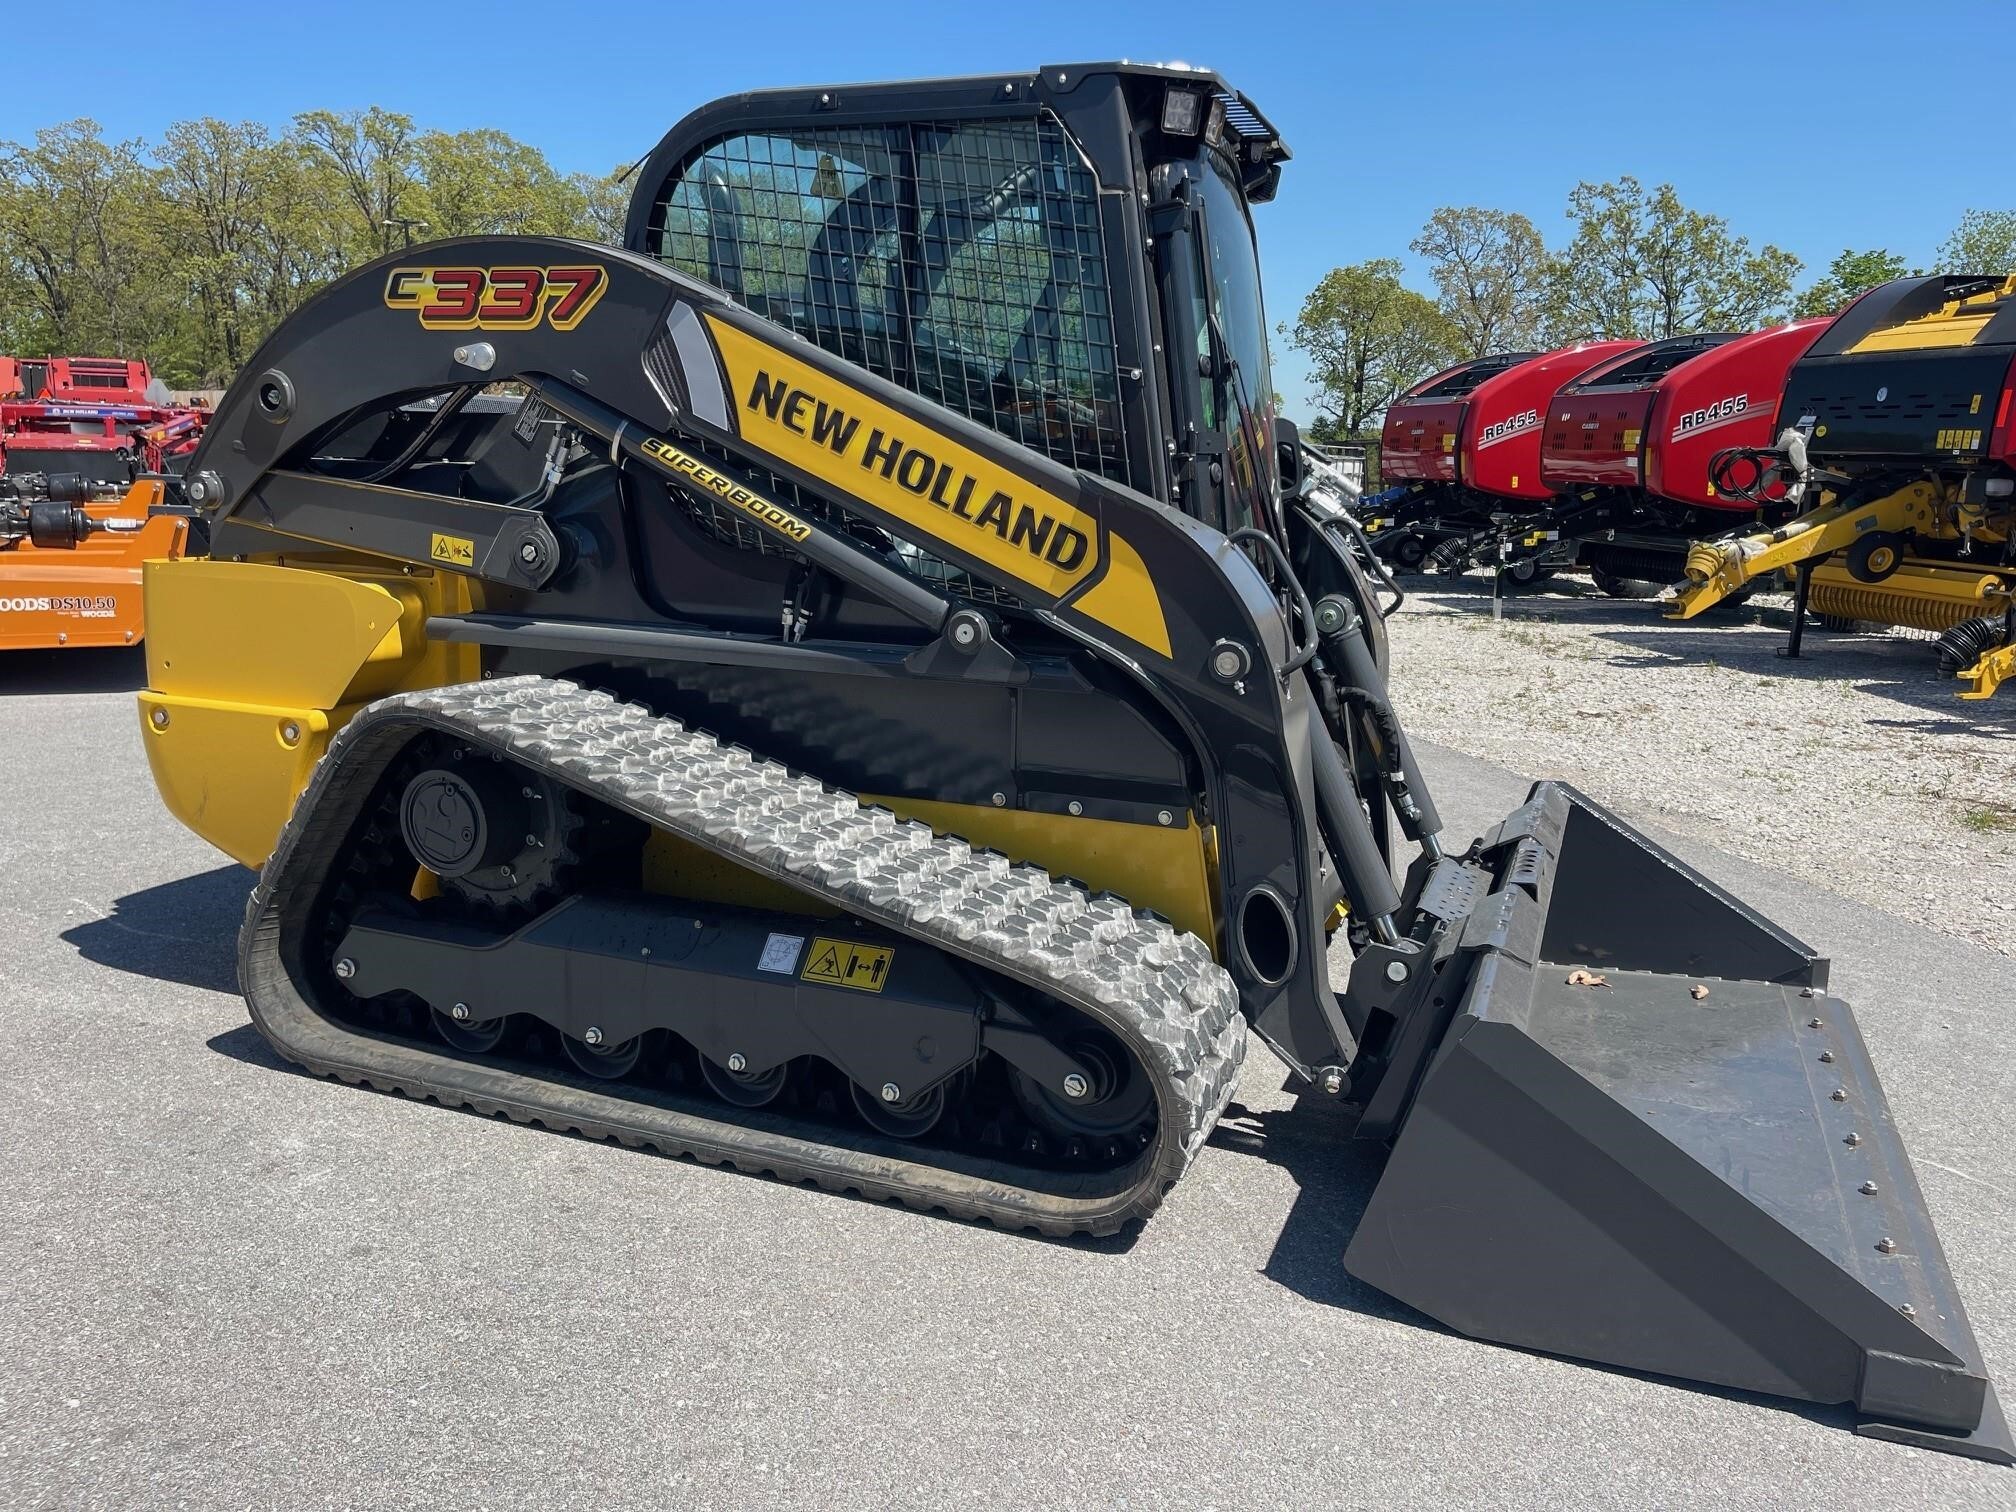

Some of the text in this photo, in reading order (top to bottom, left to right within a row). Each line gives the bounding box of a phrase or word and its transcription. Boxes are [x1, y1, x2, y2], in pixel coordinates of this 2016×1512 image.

[385, 266, 608, 330] C337
[1484, 409, 1536, 440] RB455
[1680, 394, 1748, 431] RB455
[747, 369, 1088, 573] NEW HOLLAND
[0, 596, 116, 611] OODS DS10.50
